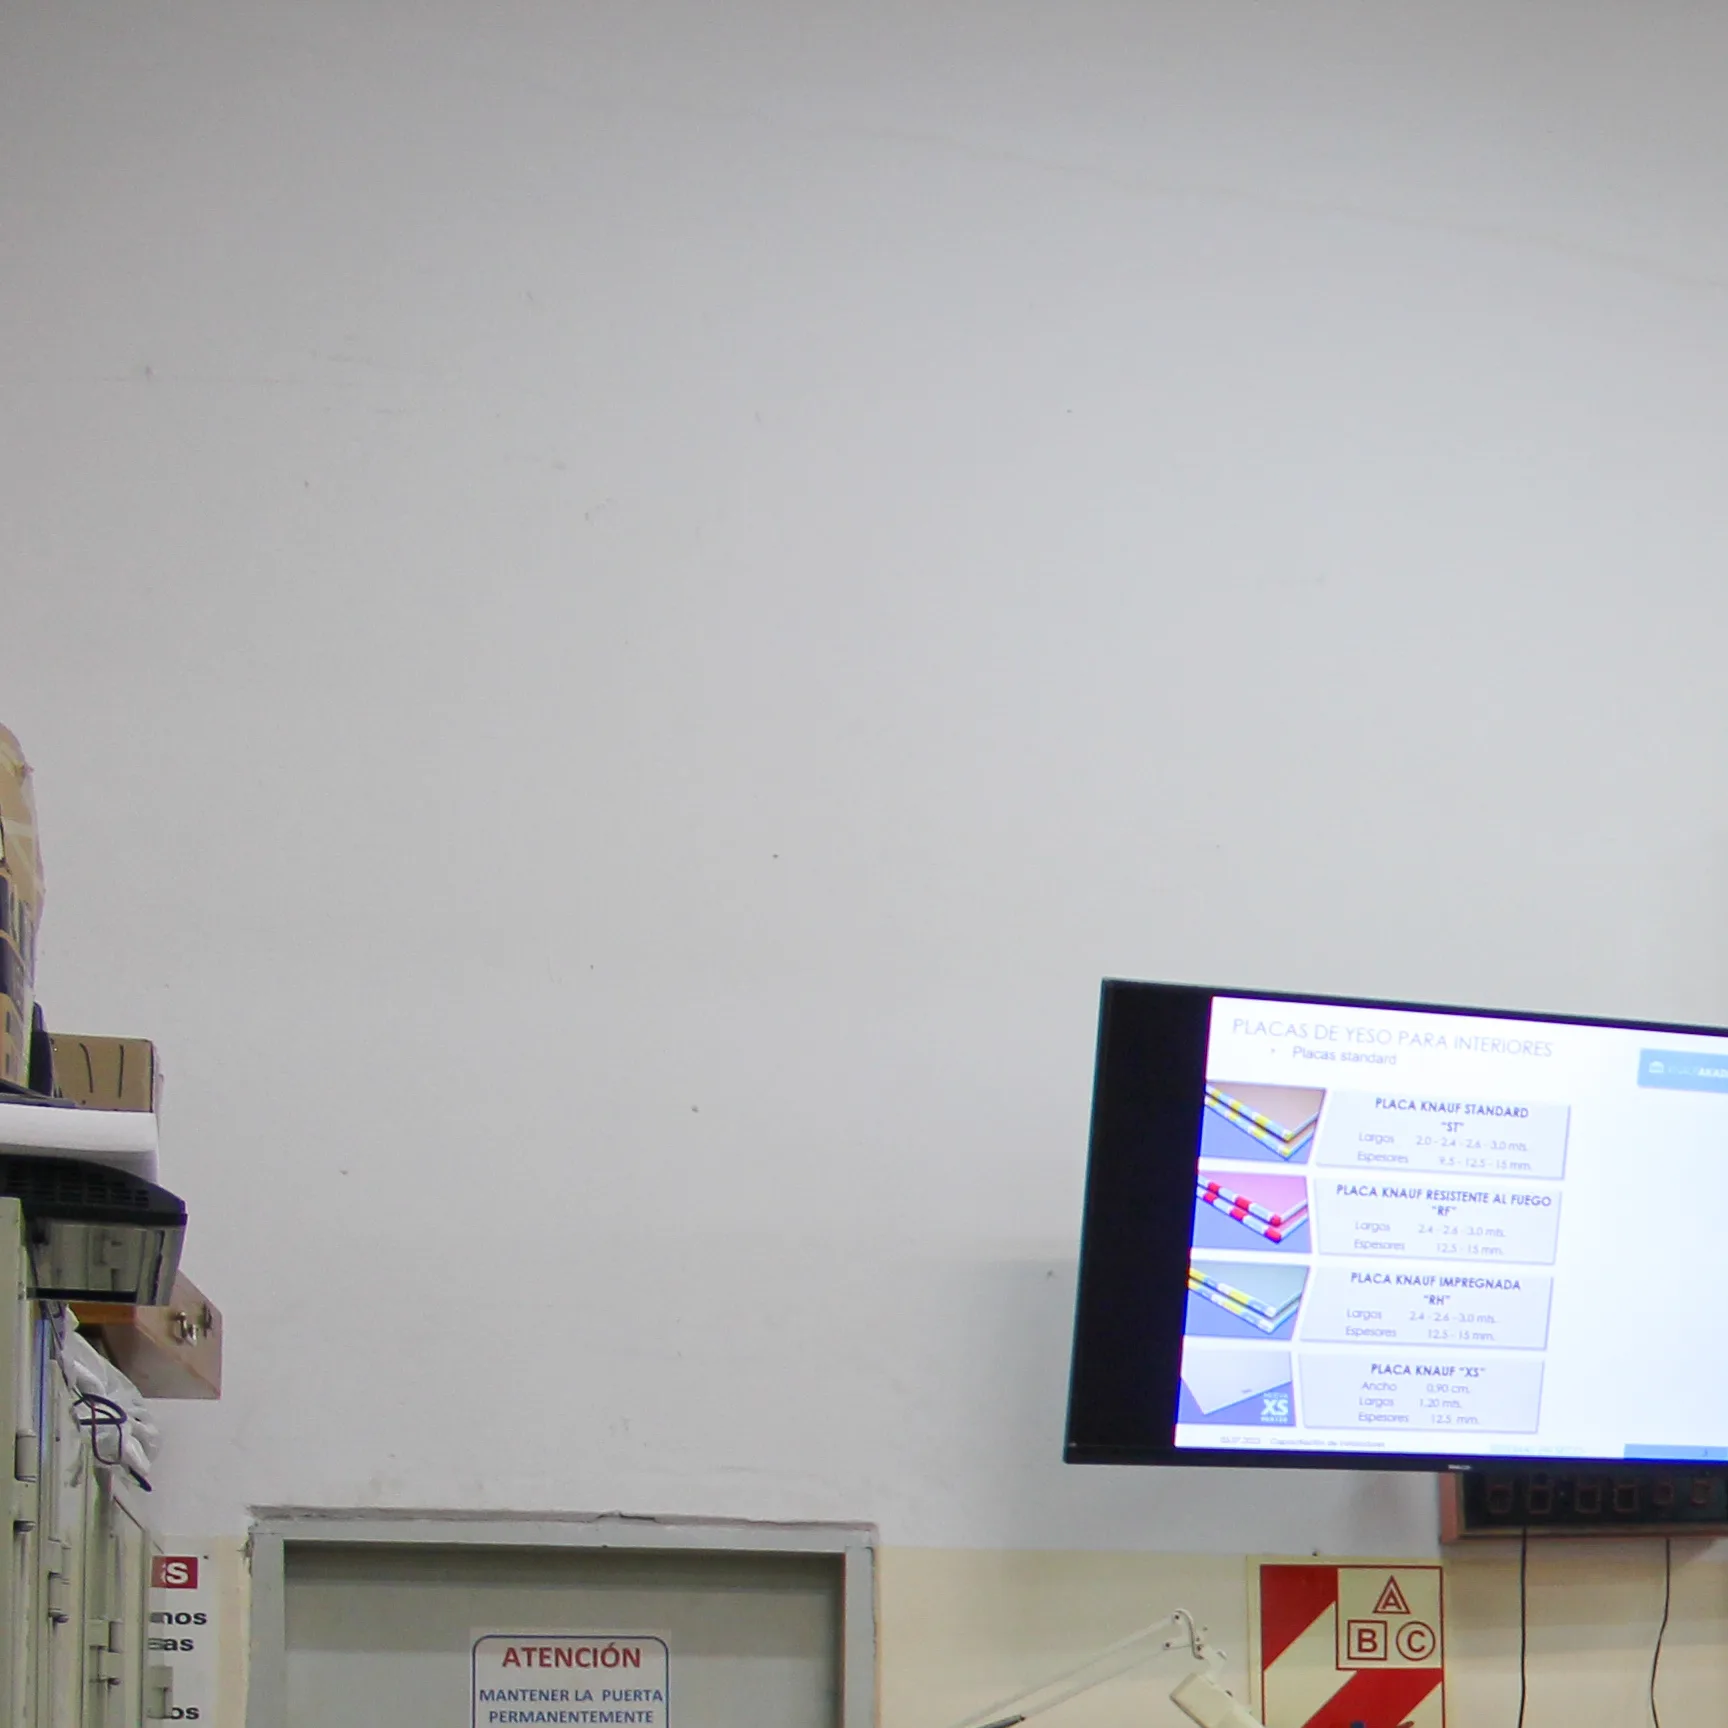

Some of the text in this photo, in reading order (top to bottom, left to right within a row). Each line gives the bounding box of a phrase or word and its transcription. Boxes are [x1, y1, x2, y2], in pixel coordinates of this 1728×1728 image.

[1232, 1018, 1553, 1057] PLACAS DE YESO PARA INTERIORES
[1292, 1046, 1397, 1065] Placas standard
[1375, 1097, 1529, 1118] PLACA KNAUF STANDARD
[1358, 1132, 1395, 1146] Largos
[1357, 1151, 1409, 1165] Espesores
[1336, 1184, 1552, 1207] PLACA KNAUF RESISTENTE AL FUEGO
[1354, 1239, 1405, 1252] Espesores
[1350, 1272, 1521, 1290] PLACA KNAUF IMPREGNADA
[1345, 1325, 1397, 1338] Espesores
[1371, 1363, 1412, 1376] PLACA
[1415, 1364, 1456, 1377] KNAUF
[1361, 1381, 1397, 1392] Ancho
[1260, 1399, 1289, 1416] XS
[1358, 1412, 1409, 1424] Espesores
[1382, 1590, 1402, 1610] A
[1358, 1628, 1425, 1653] B C
[502, 1642, 641, 1668] ATENCIÓN
[479, 1689, 664, 1702] MANTENER LA PUERTA
[489, 1711, 653, 1723] PERMANENTEMENTE
